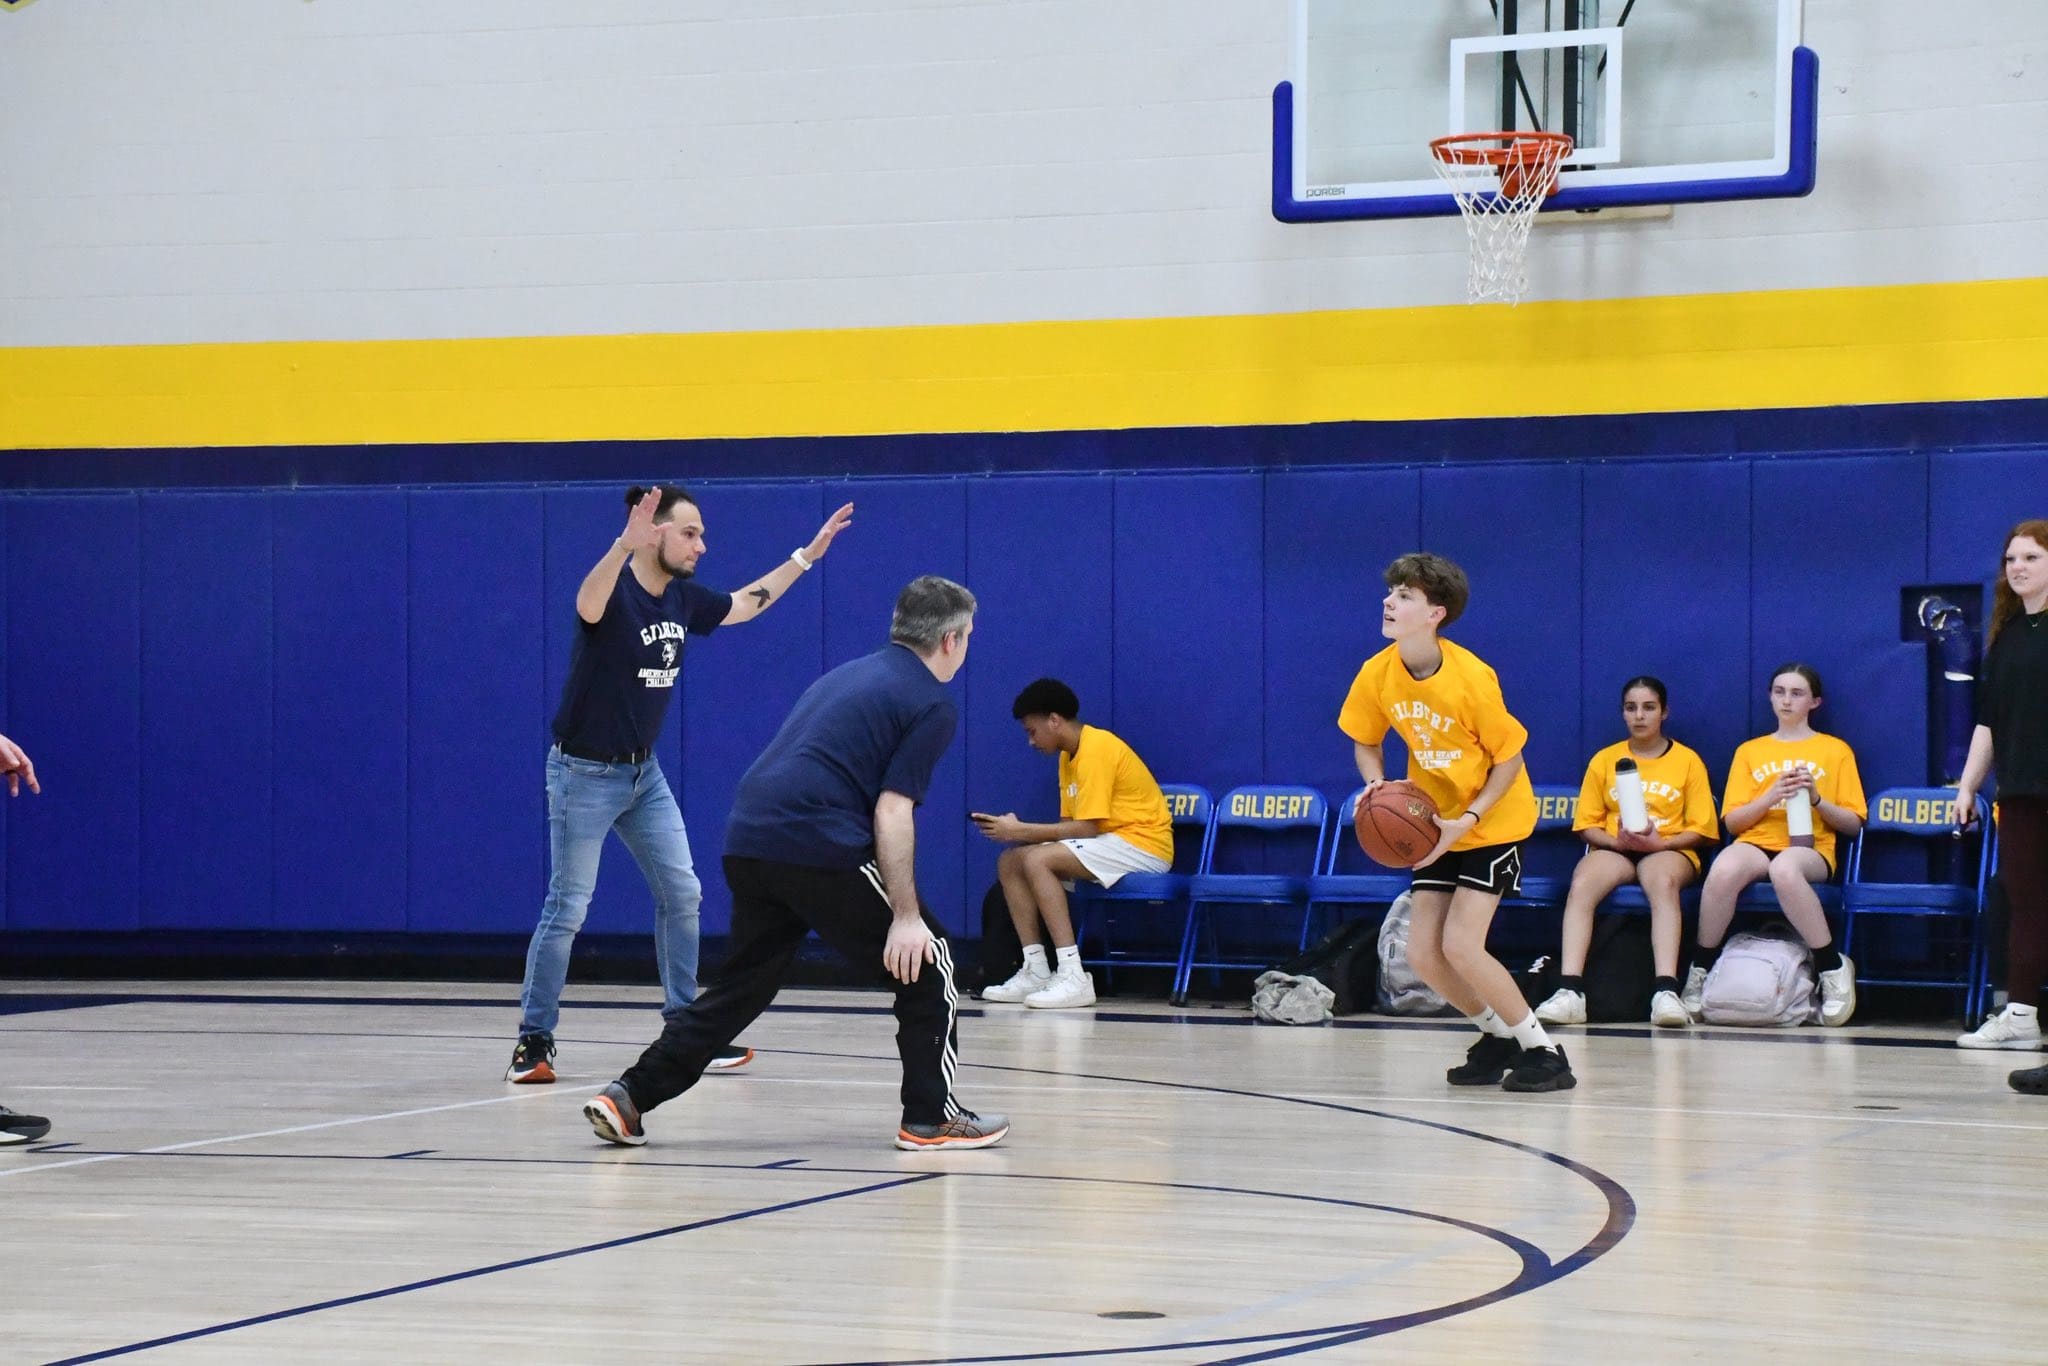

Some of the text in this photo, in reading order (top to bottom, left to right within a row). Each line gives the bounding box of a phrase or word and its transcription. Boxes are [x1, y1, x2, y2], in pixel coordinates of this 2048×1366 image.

[640, 621, 688, 646] GILBER
[1391, 701, 1455, 733] ILBERT
[1609, 780, 1681, 802] GBERT
[1231, 794, 1313, 819] GILBERT
